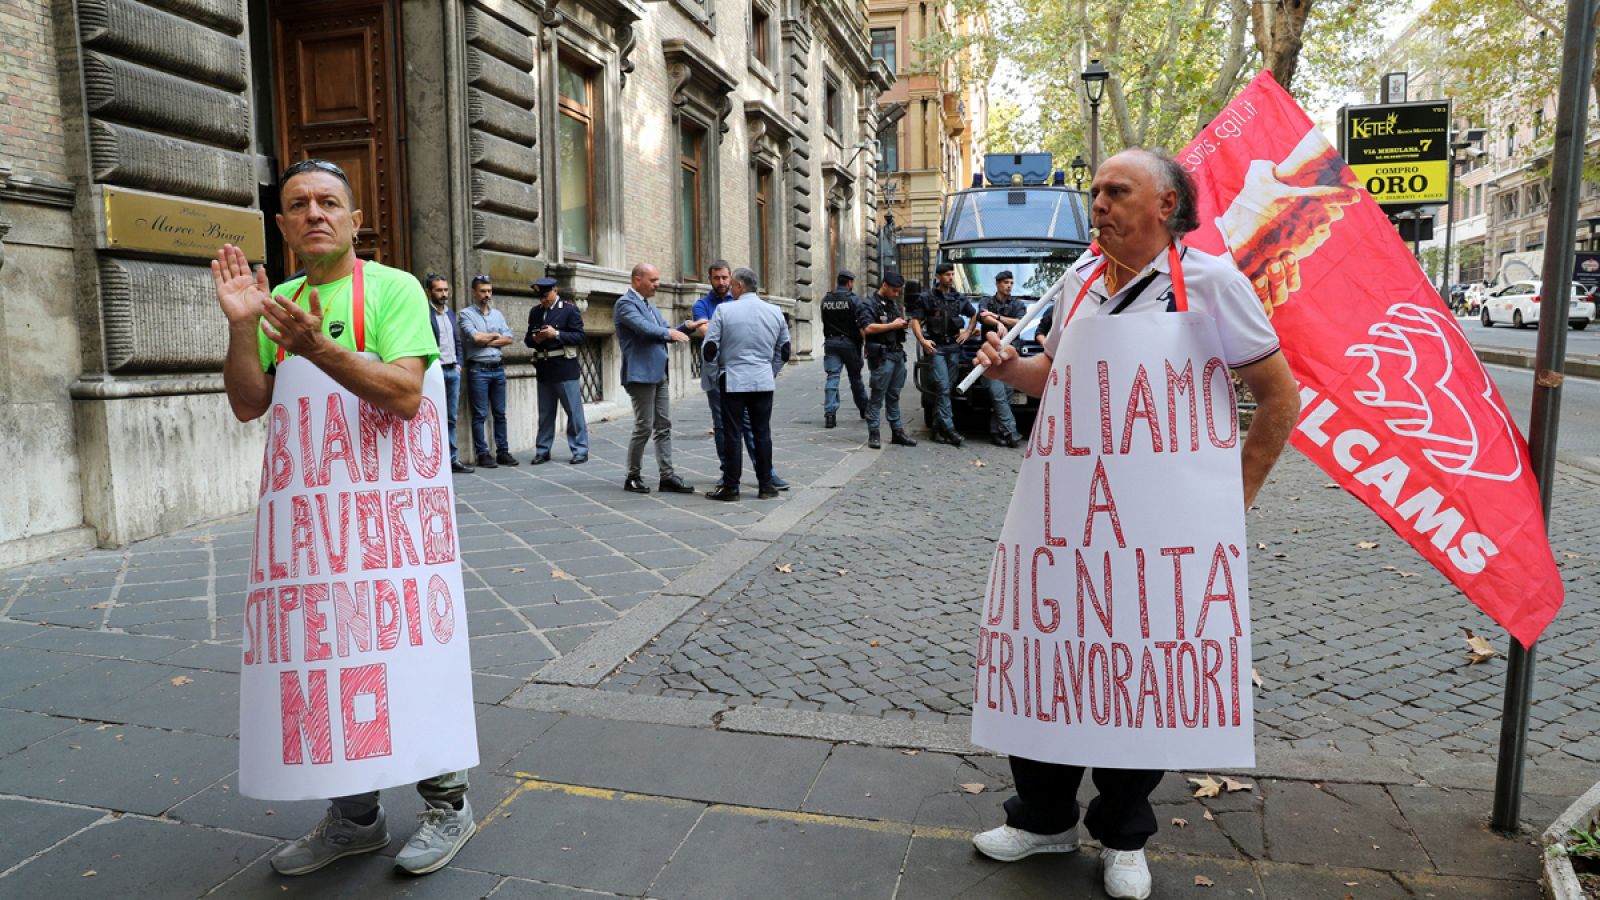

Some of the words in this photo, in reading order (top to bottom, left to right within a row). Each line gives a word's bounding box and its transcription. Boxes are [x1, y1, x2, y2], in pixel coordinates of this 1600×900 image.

[1351, 117, 1394, 139] KETER
[1420, 139, 1433, 152] 7
[1366, 174, 1428, 195] ORO
[1375, 166, 1419, 175] COMPRO
[135, 215, 194, 235] Marco
[202, 222, 248, 243] Biagi
[823, 300, 850, 310] POLIZIA
[1295, 380, 1500, 575] LCAMS
[1044, 455, 1127, 549] LA
[244, 573, 456, 666] STIPENDIO
[974, 627, 1018, 716] PER
[1034, 636, 1241, 729] LAVORATORI
[279, 662, 393, 765] NO
